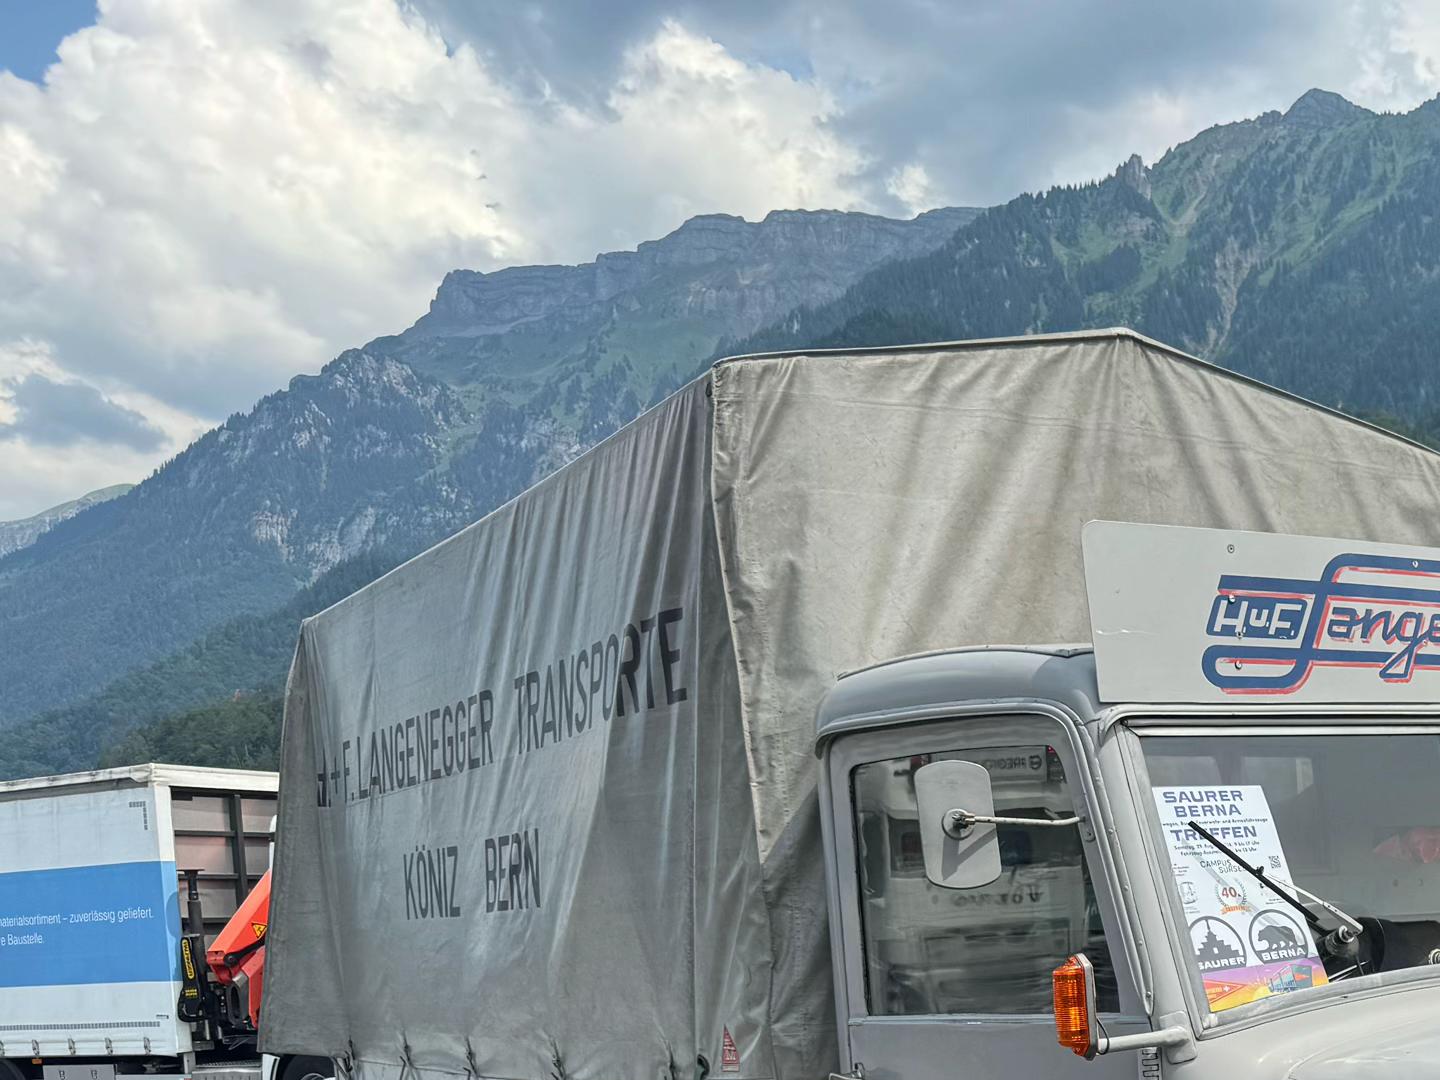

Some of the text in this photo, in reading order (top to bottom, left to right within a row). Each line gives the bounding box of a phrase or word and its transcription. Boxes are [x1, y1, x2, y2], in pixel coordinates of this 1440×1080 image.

[514, 608, 688, 754] TRANSPORTE
[1162, 790, 1243, 804] SAURER
[1174, 804, 1242, 818] BERNA
[1200, 859, 1232, 869] CAMPUS
[1218, 865, 1247, 874] SURSE
[403, 828, 541, 920] KÖNIZ BERN
[1262, 947, 1306, 961] BERNA
